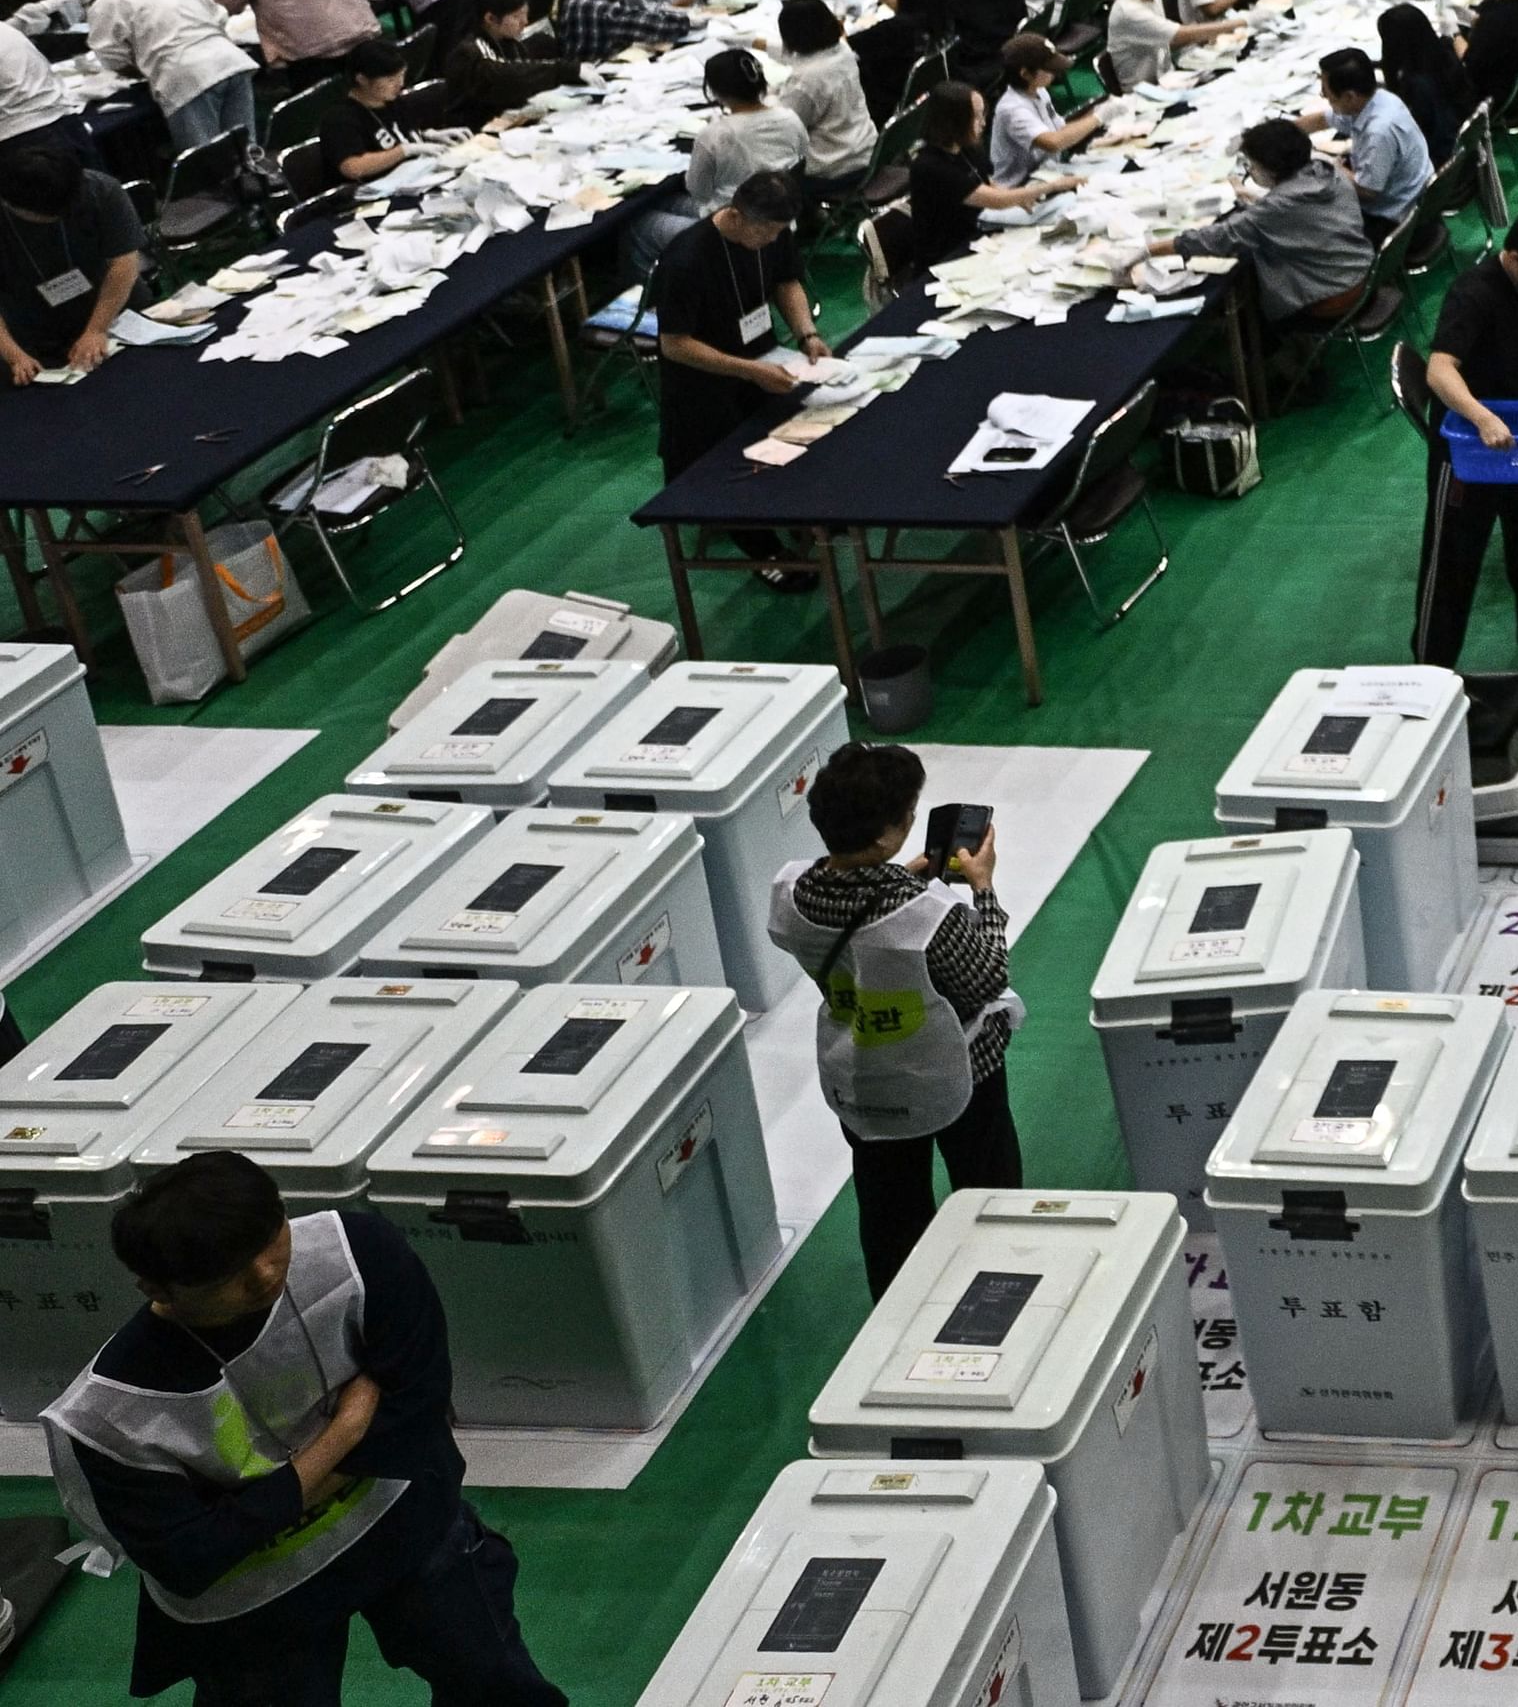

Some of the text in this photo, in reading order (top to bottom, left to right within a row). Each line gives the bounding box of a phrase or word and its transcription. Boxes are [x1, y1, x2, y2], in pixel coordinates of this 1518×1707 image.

[1279, 1296, 1387, 1322] 투표함
[1246, 1491, 1430, 1541] 1차 교부
[1242, 1571, 1368, 1612] 서원동
[1184, 1622, 1379, 1666] 제2투표소
